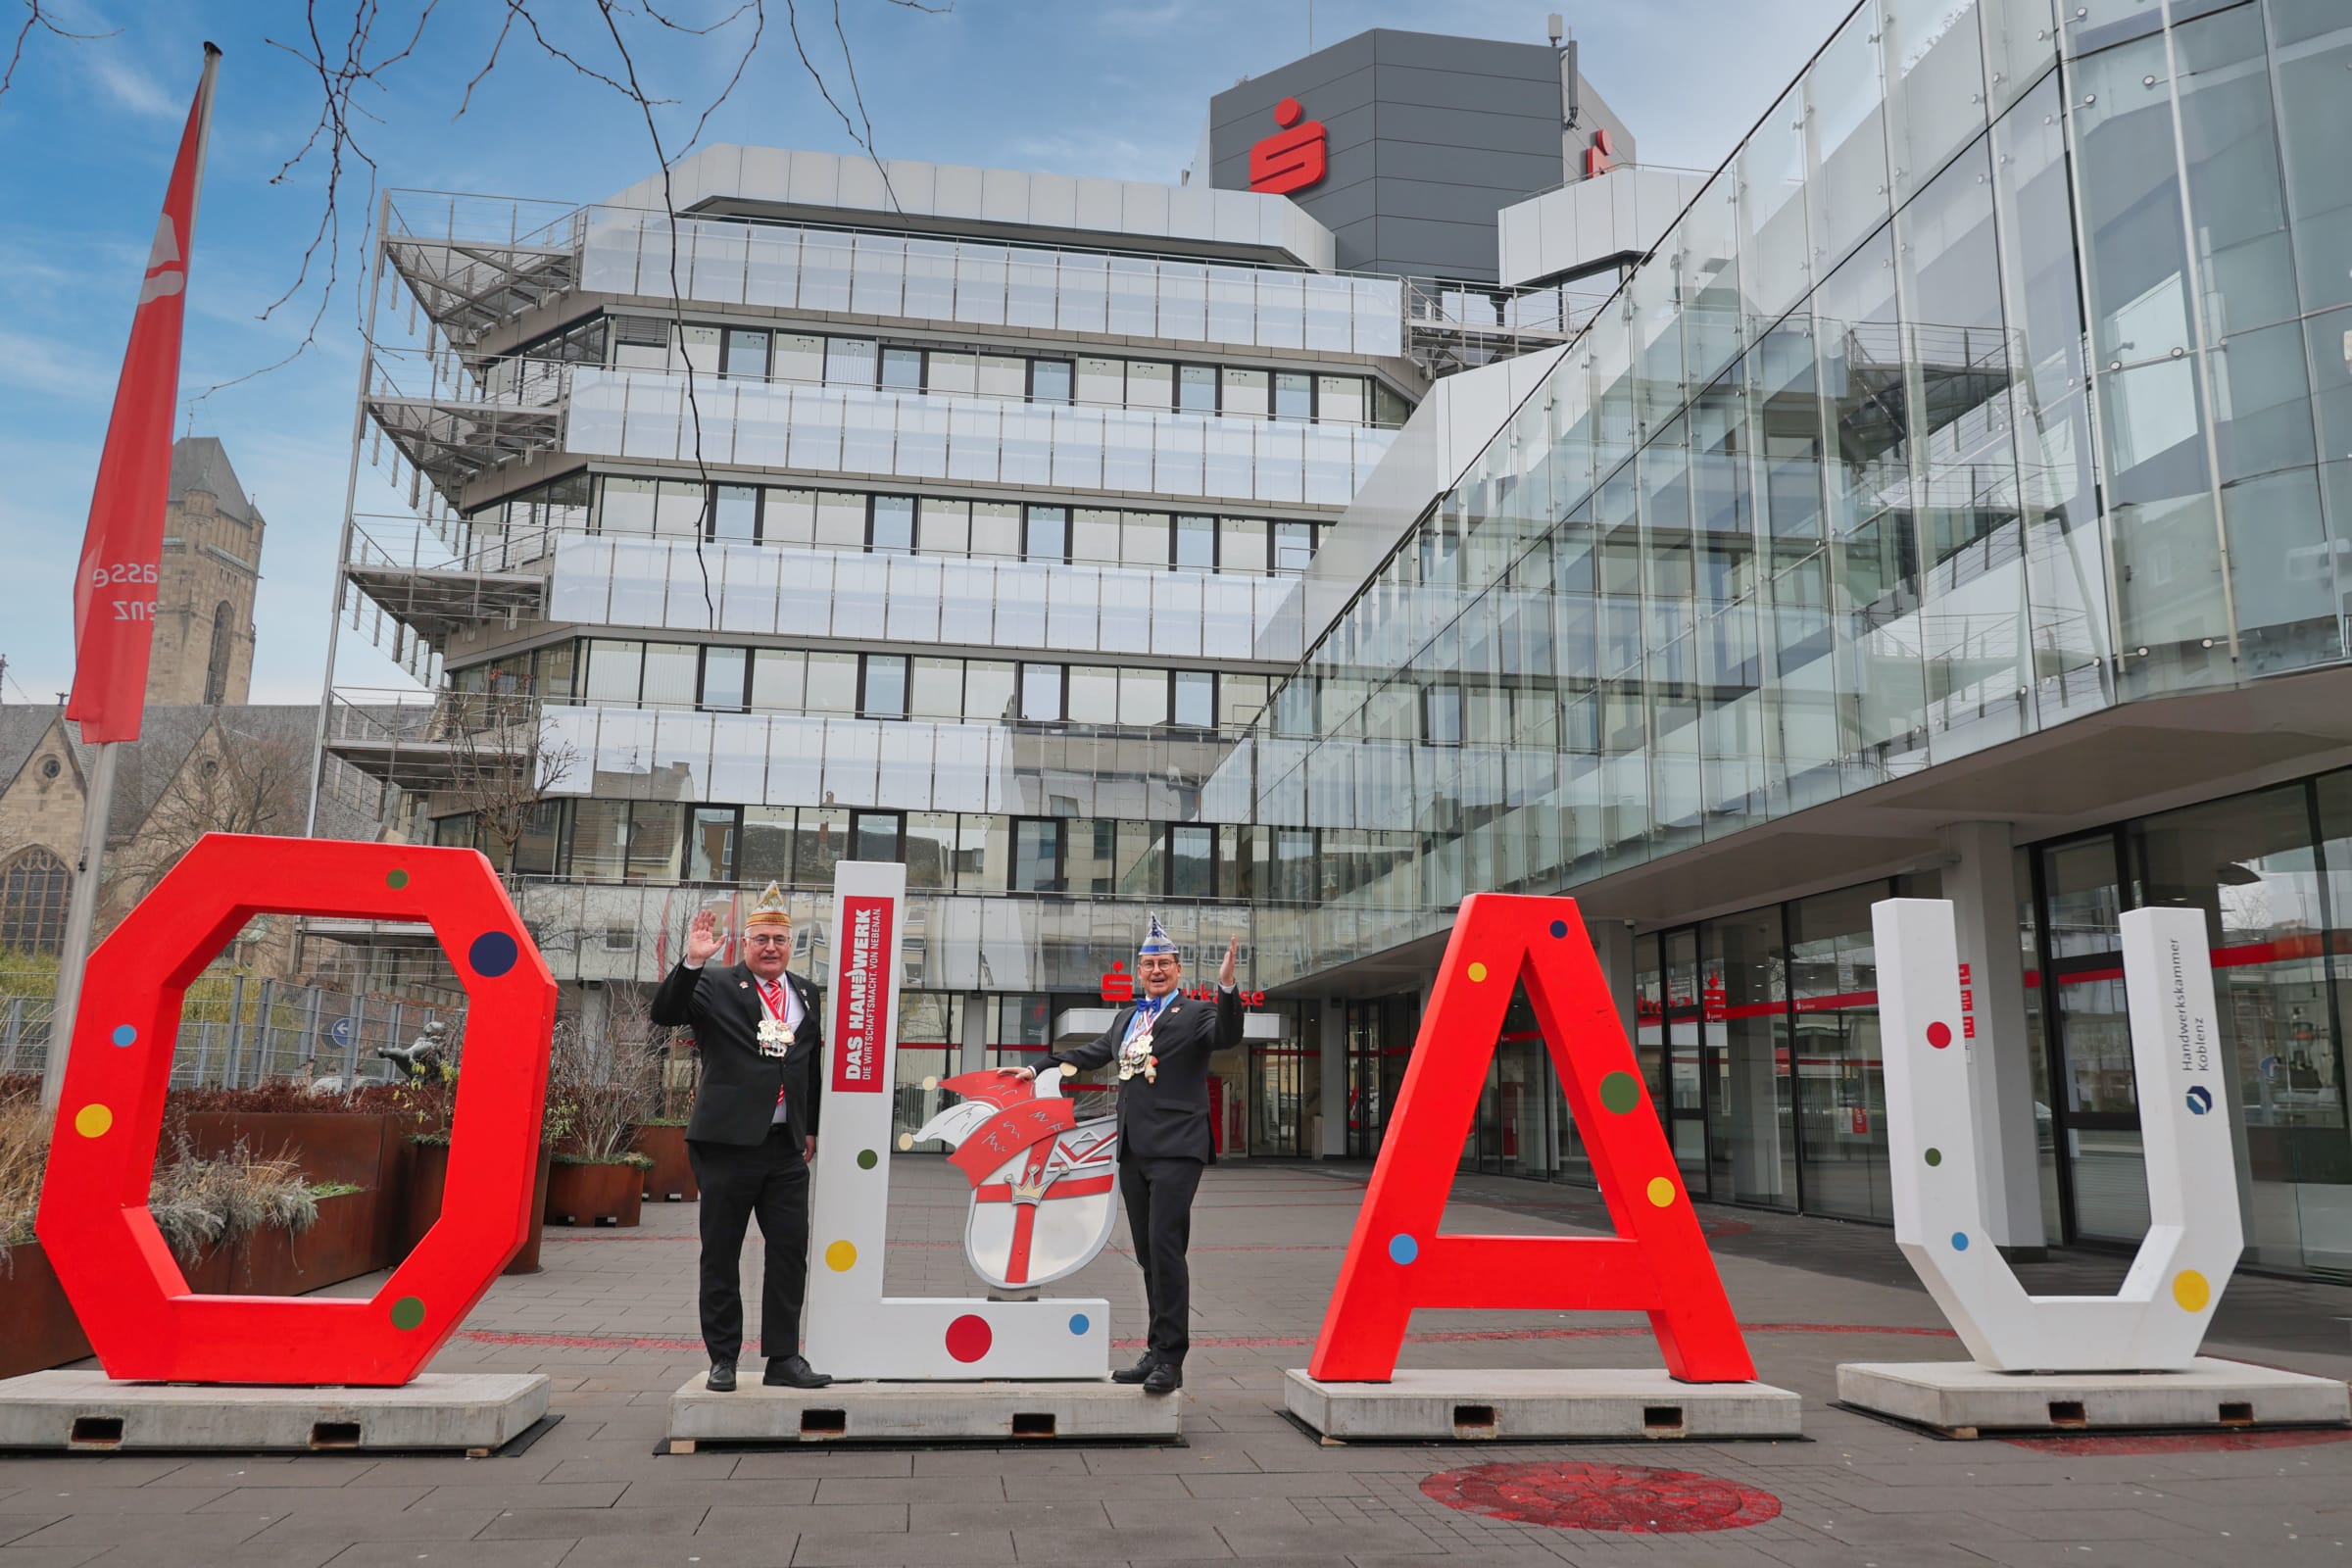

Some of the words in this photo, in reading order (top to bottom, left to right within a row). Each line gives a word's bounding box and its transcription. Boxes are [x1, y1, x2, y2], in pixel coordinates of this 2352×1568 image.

[870, 907, 882, 950] NEBENAN.
[869, 952, 879, 969] VON
[863, 971, 878, 1064] WIRTSCHAFTSMACHT.
[2170, 938, 2193, 1071] Handwerkskammer
[845, 1036, 863, 1080] DAS
[2194, 1016, 2210, 1071] Koblenz
[862, 1065, 872, 1080] DIE
